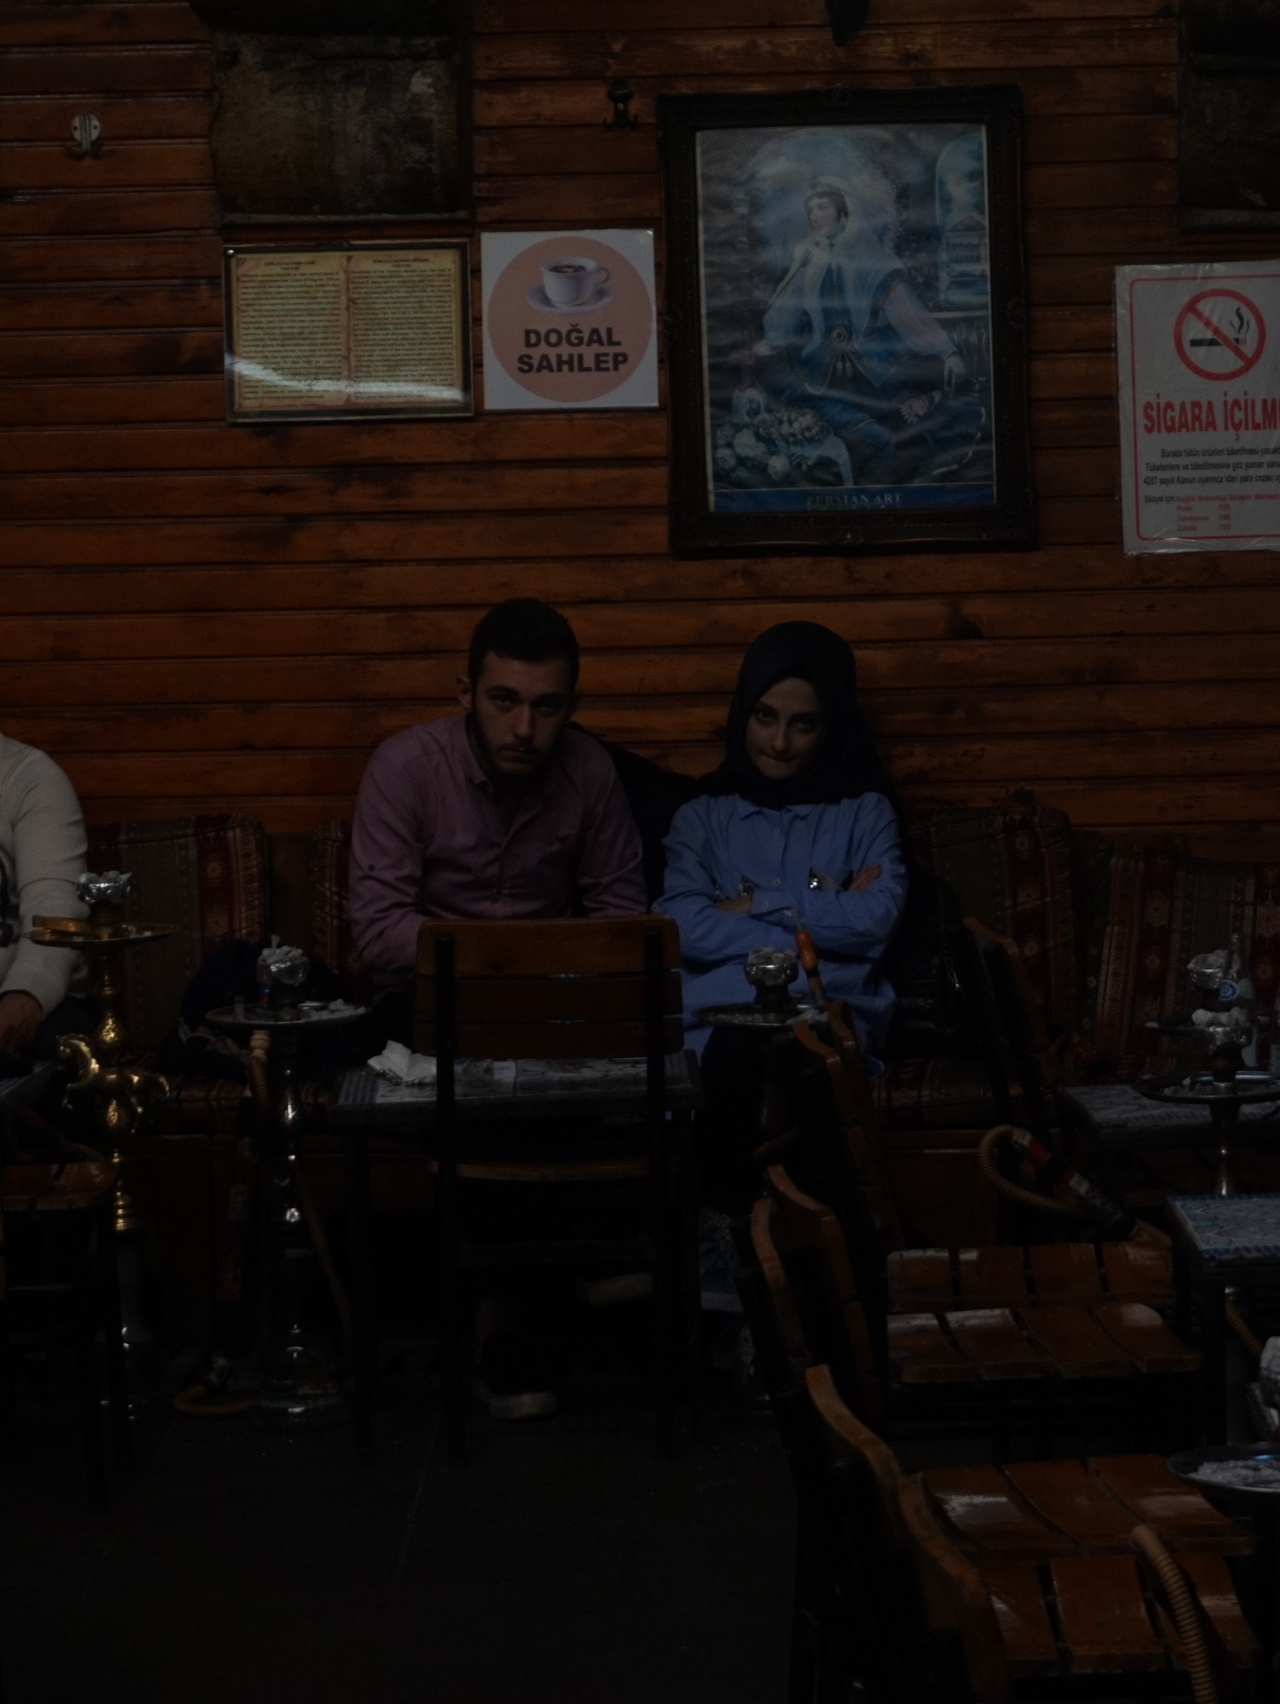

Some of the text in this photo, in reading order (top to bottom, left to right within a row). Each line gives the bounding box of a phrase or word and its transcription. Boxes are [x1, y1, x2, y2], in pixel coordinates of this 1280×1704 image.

[524, 323, 622, 348] DOĞAL
[517, 352, 629, 374] SAHLEP
[1143, 393, 1217, 434] SİGARA
[806, 493, 902, 505] PERSIAN ART
